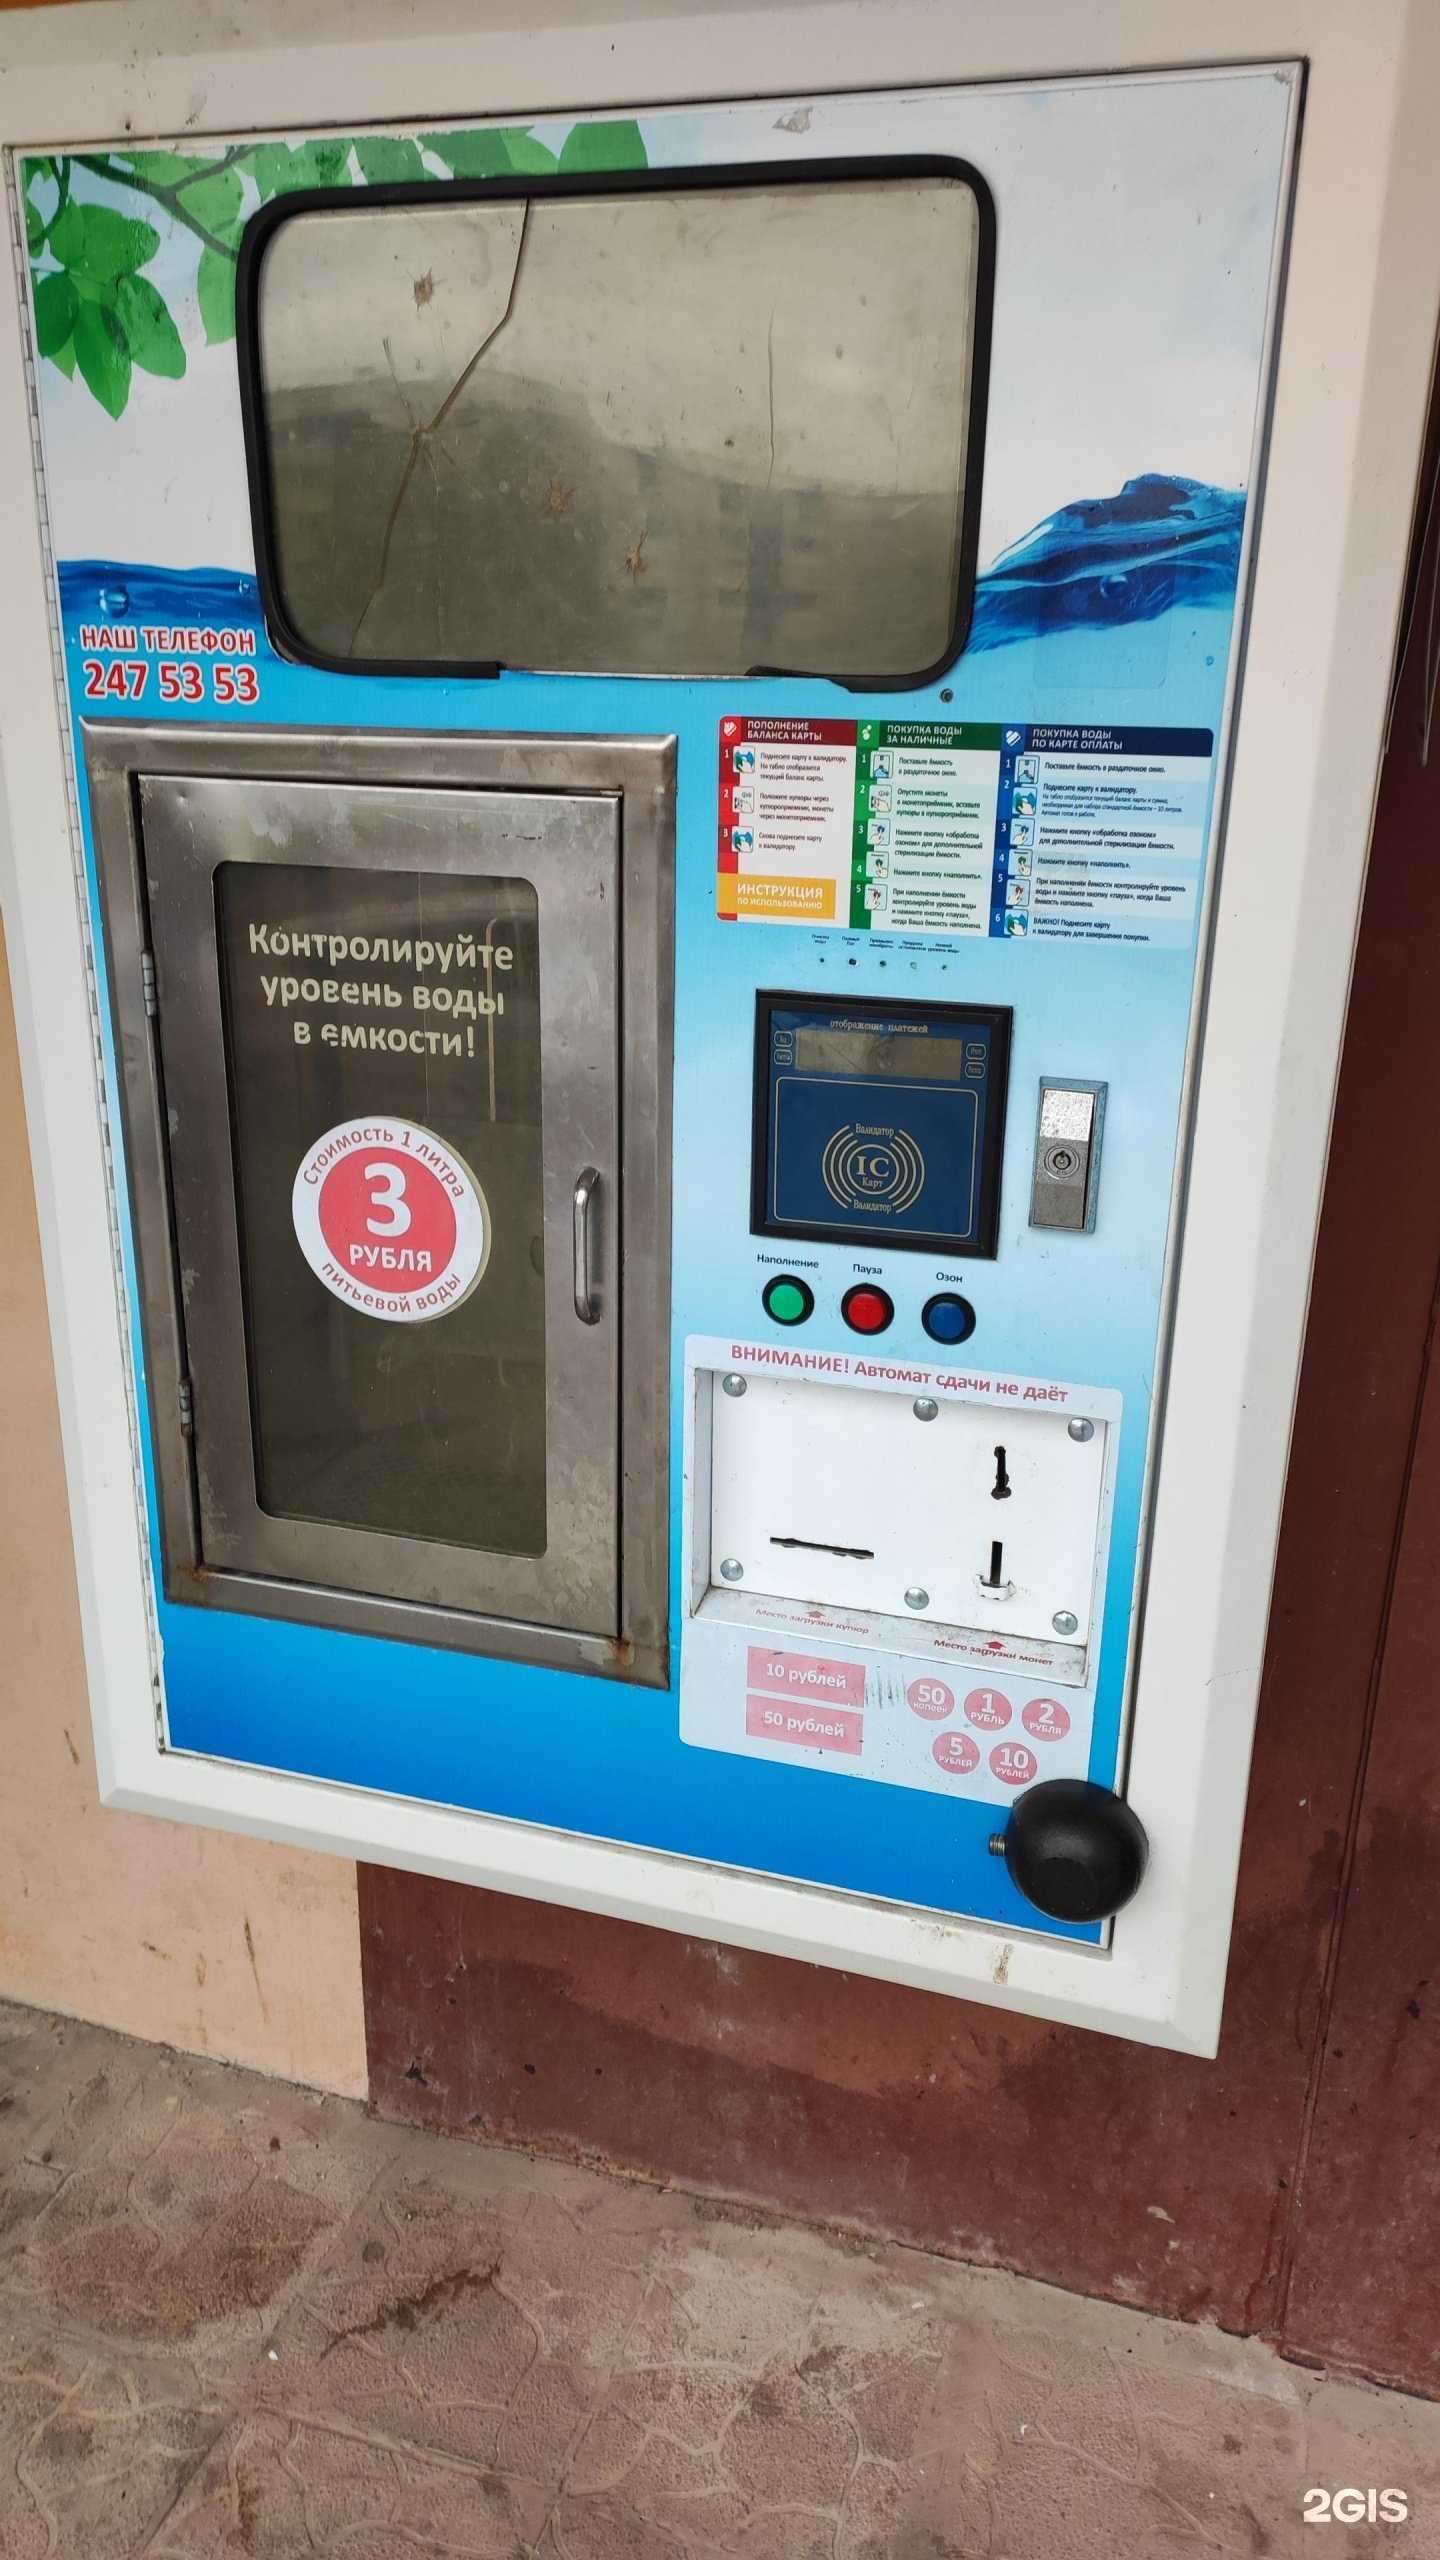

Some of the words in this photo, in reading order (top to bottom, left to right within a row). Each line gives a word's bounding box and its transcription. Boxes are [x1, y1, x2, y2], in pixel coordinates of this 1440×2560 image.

[80, 626, 137, 650] НАШ
[142, 628, 254, 653] ТЕЛЕФОН
[84, 662, 147, 697] 247
[159, 664, 203, 700] 53
[214, 666, 258, 702] 53
[747, 720, 809, 731] ПОПОЛНЕНИЕ
[888, 725, 933, 734] ПОКУПКА
[935, 726, 962, 737] ВОДЫ
[747, 730, 789, 740] БАЛАНСА
[791, 732, 822, 741] КАРТЫ
[887, 735, 898, 743] ЗА
[900, 736, 953, 745] НАЛИЧНЫЕ
[1033, 728, 1079, 739] ПОКУПКА
[1081, 730, 1111, 740] ВОДЫ
[1032, 739, 1046, 748] ПО
[1048, 740, 1078, 748] КАРТЕ
[1080, 740, 1123, 750] ОПЛАТЫ
[724, 749, 729, 758] 1
[862, 754, 866, 764] 1
[1006, 759, 1010, 768] 1
[860, 784, 865, 794] 2
[1004, 780, 1010, 789] 2
[724, 789, 729, 798] 2
[723, 828, 728, 838] 3
[859, 825, 864, 834] 3
[1001, 823, 1007, 832] 3
[999, 854, 1005, 863] 4
[856, 865, 862, 873] 4
[998, 874, 1003, 882] 5
[737, 883, 823, 899] ИНСТРУКЦИЯ
[995, 914, 1000, 922] 6
[250, 923, 513, 973] Контролируйте
[261, 975, 401, 1007] уровень
[412, 986, 504, 1020] воды
[293, 1021, 311, 1045] в
[855, 1123, 895, 1138] Валидатор
[303, 1128, 394, 1185] Стоимость
[400, 1130, 411, 1148] 1
[416, 1143, 464, 1198] литра
[862, 1177, 883, 1190] Карт
[364, 1161, 411, 1237] 3
[853, 1199, 893, 1214] Валидатор
[349, 1243, 433, 1273] РУБЛЯ
[756, 1253, 819, 1269] Наполнение
[853, 1264, 883, 1276] Пауза
[936, 1272, 963, 1283] Озон
[322, 1262, 411, 1313] питьевой
[416, 1273, 461, 1310] воды
[731, 1344, 850, 1374] ВНИМАНИЕ!
[854, 1361, 932, 1385] Автомат
[935, 1373, 991, 1394] сдачи
[996, 1381, 1019, 1397] не
[1023, 1383, 1068, 1403] даёт
[755, 1608, 788, 1621] Место
[788, 1616, 834, 1629] загрузки
[934, 1640, 968, 1653] Место
[971, 1644, 1017, 1660] загрузки
[1019, 1652, 1054, 1666] монет
[765, 1663, 785, 1677] 10
[788, 1666, 848, 1689] рублей
[917, 1686, 947, 1704] 50
[981, 1692, 994, 1715] 1
[970, 1711, 1005, 1726] РУБЛЬ
[1039, 1703, 1055, 1724] 2
[763, 1710, 784, 1726] 50
[787, 1713, 845, 1738] рублей
[1029, 1720, 1062, 1735] РУБЛЯ
[949, 1737, 964, 1757] 5
[999, 1747, 1029, 1769] 10
